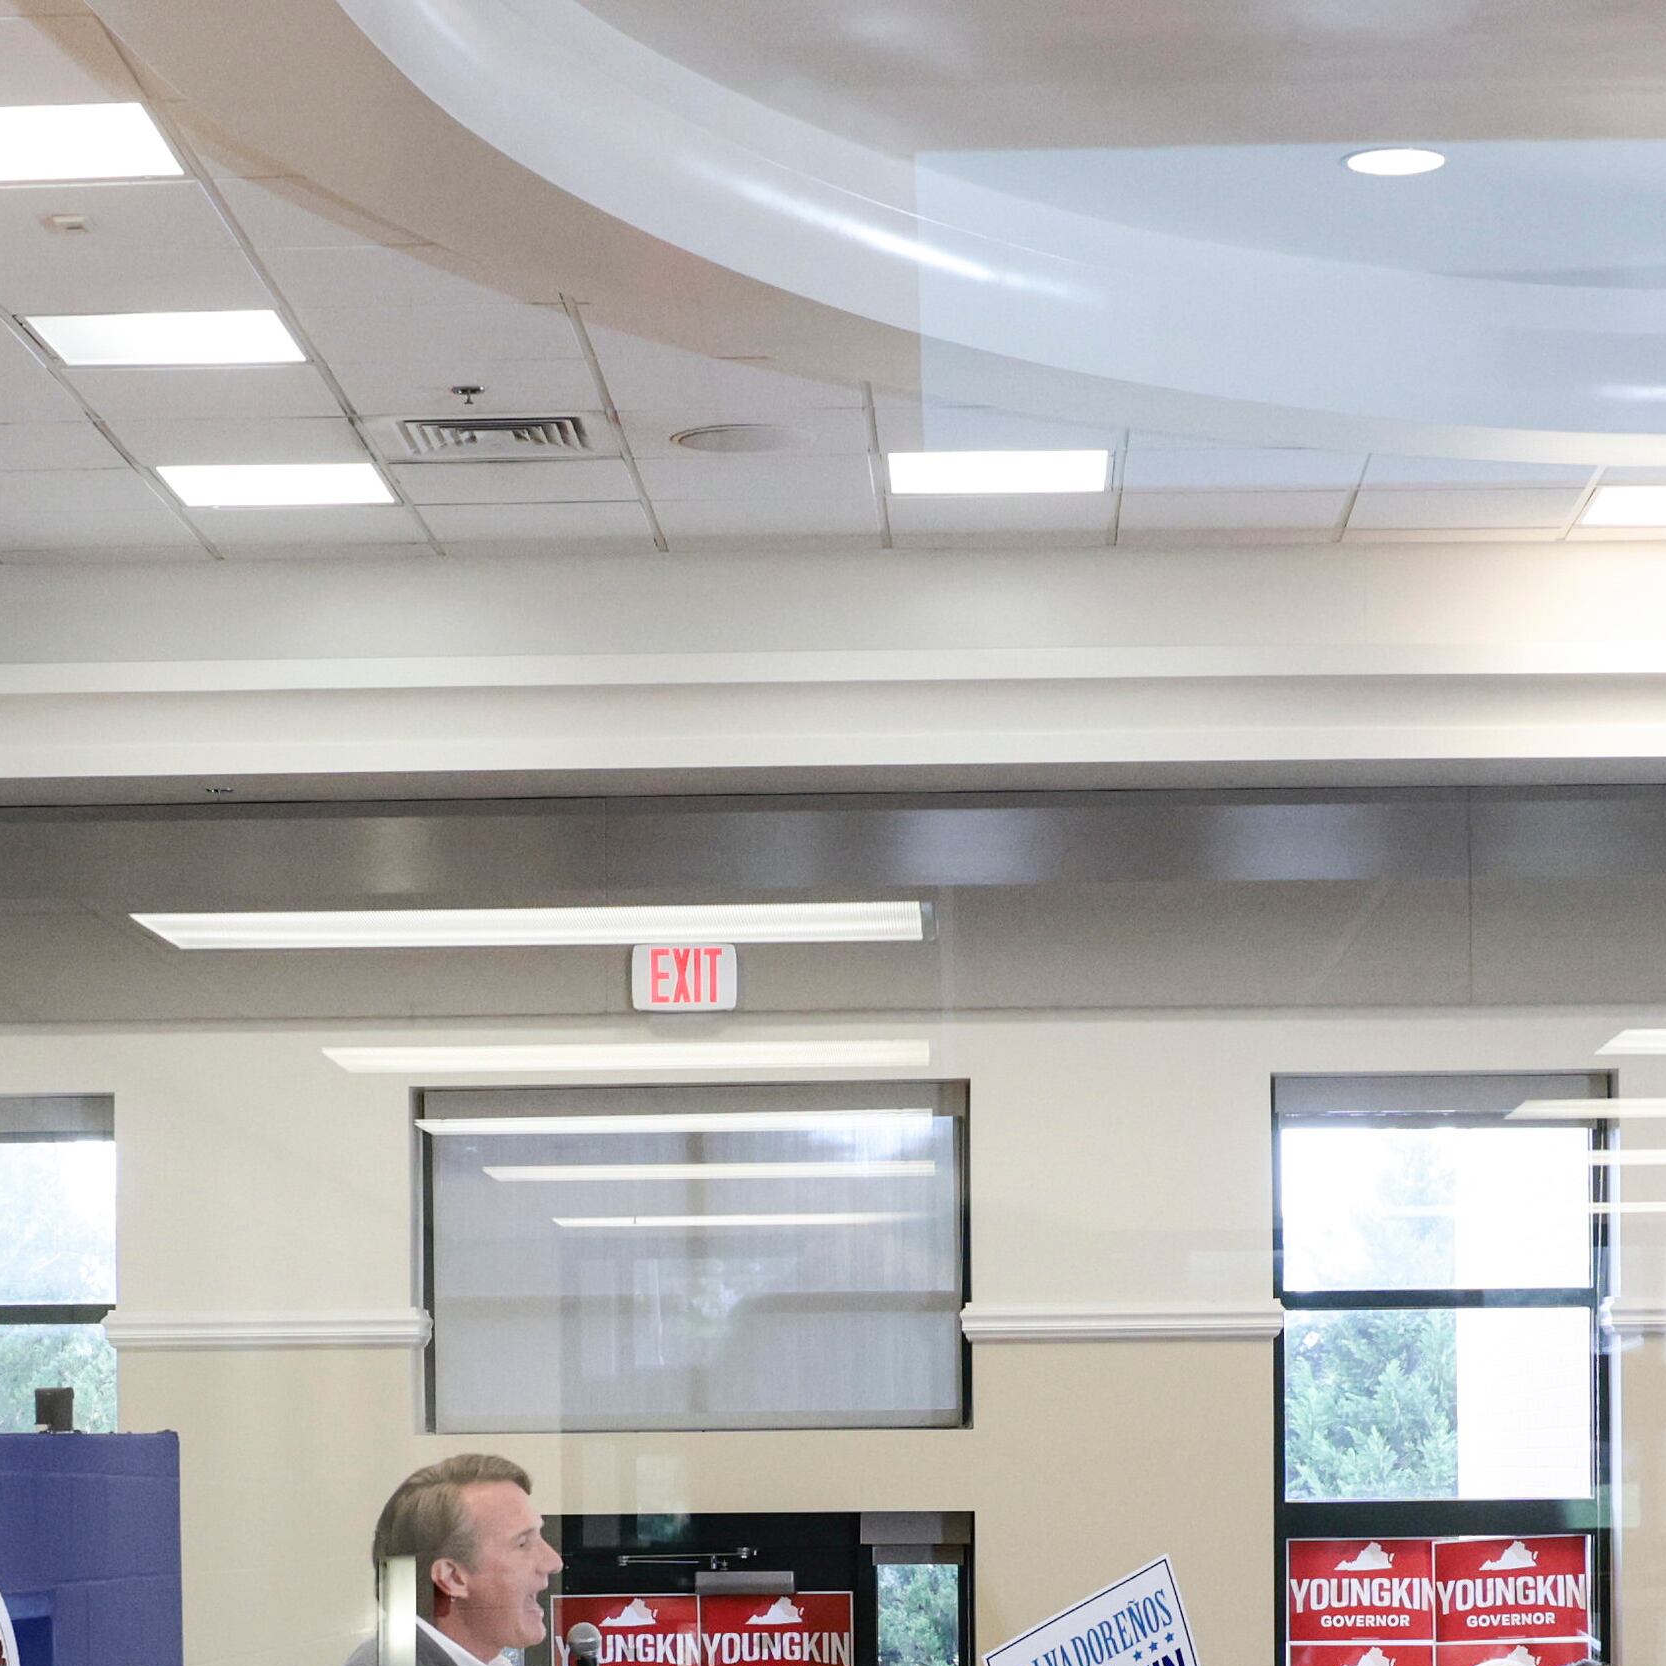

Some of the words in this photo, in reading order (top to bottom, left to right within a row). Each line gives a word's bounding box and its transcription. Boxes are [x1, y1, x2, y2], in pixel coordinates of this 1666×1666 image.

[650, 947, 723, 1004] EXIT
[1436, 1573, 1587, 1615] YOUNGKIN
[1320, 1614, 1411, 1628] GOVERNOR
[1466, 1611, 1556, 1629] GOVERNOR
